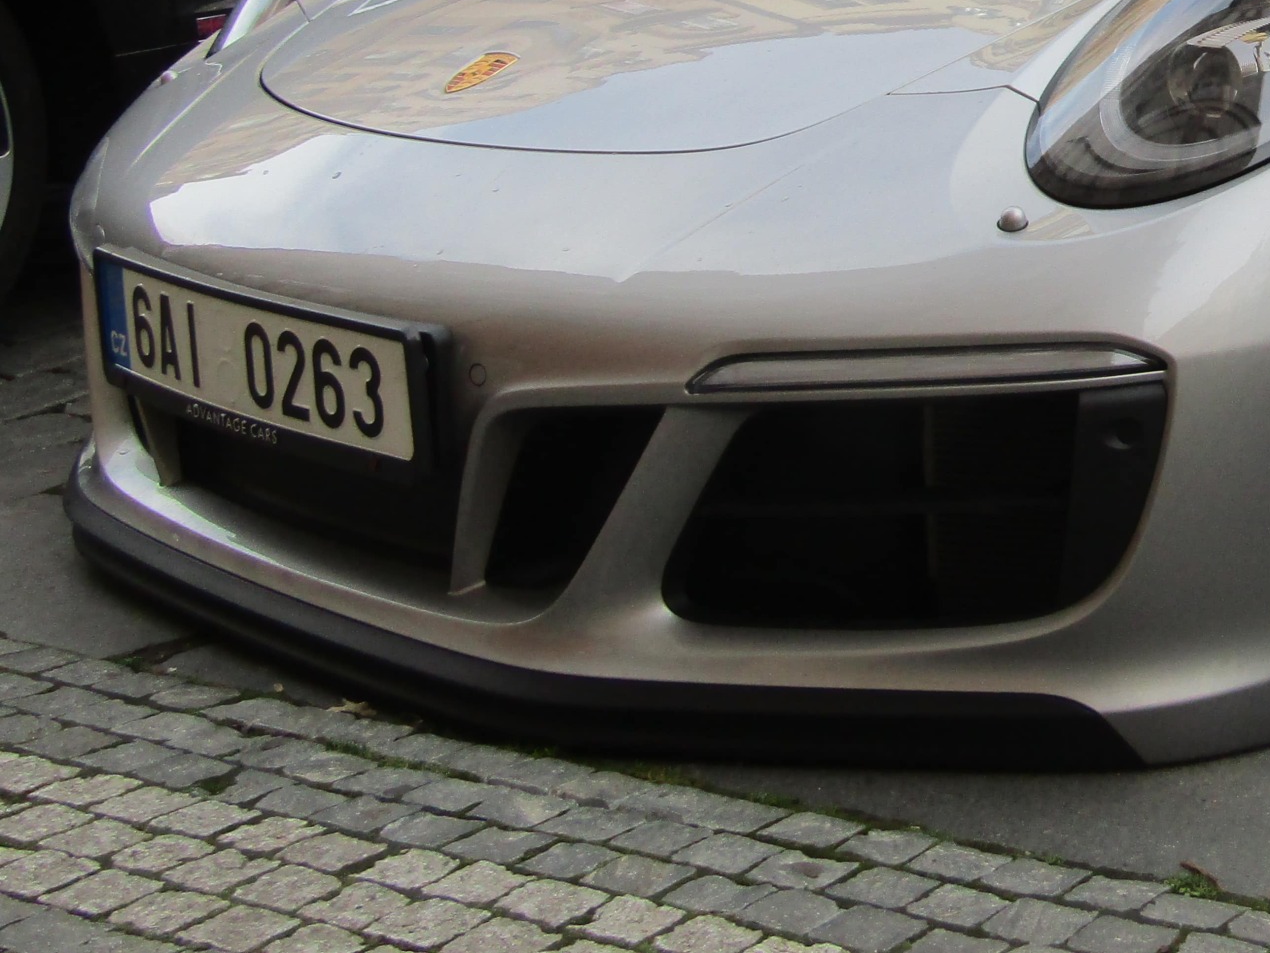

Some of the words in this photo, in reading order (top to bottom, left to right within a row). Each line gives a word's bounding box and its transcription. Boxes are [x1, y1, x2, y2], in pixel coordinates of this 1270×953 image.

[110, 330, 128, 357] CZ
[132, 283, 200, 388] 6AI
[244, 320, 384, 438] 0263
[186, 403, 247, 435] ADVANTAGE
[250, 423, 278, 444] CARS
